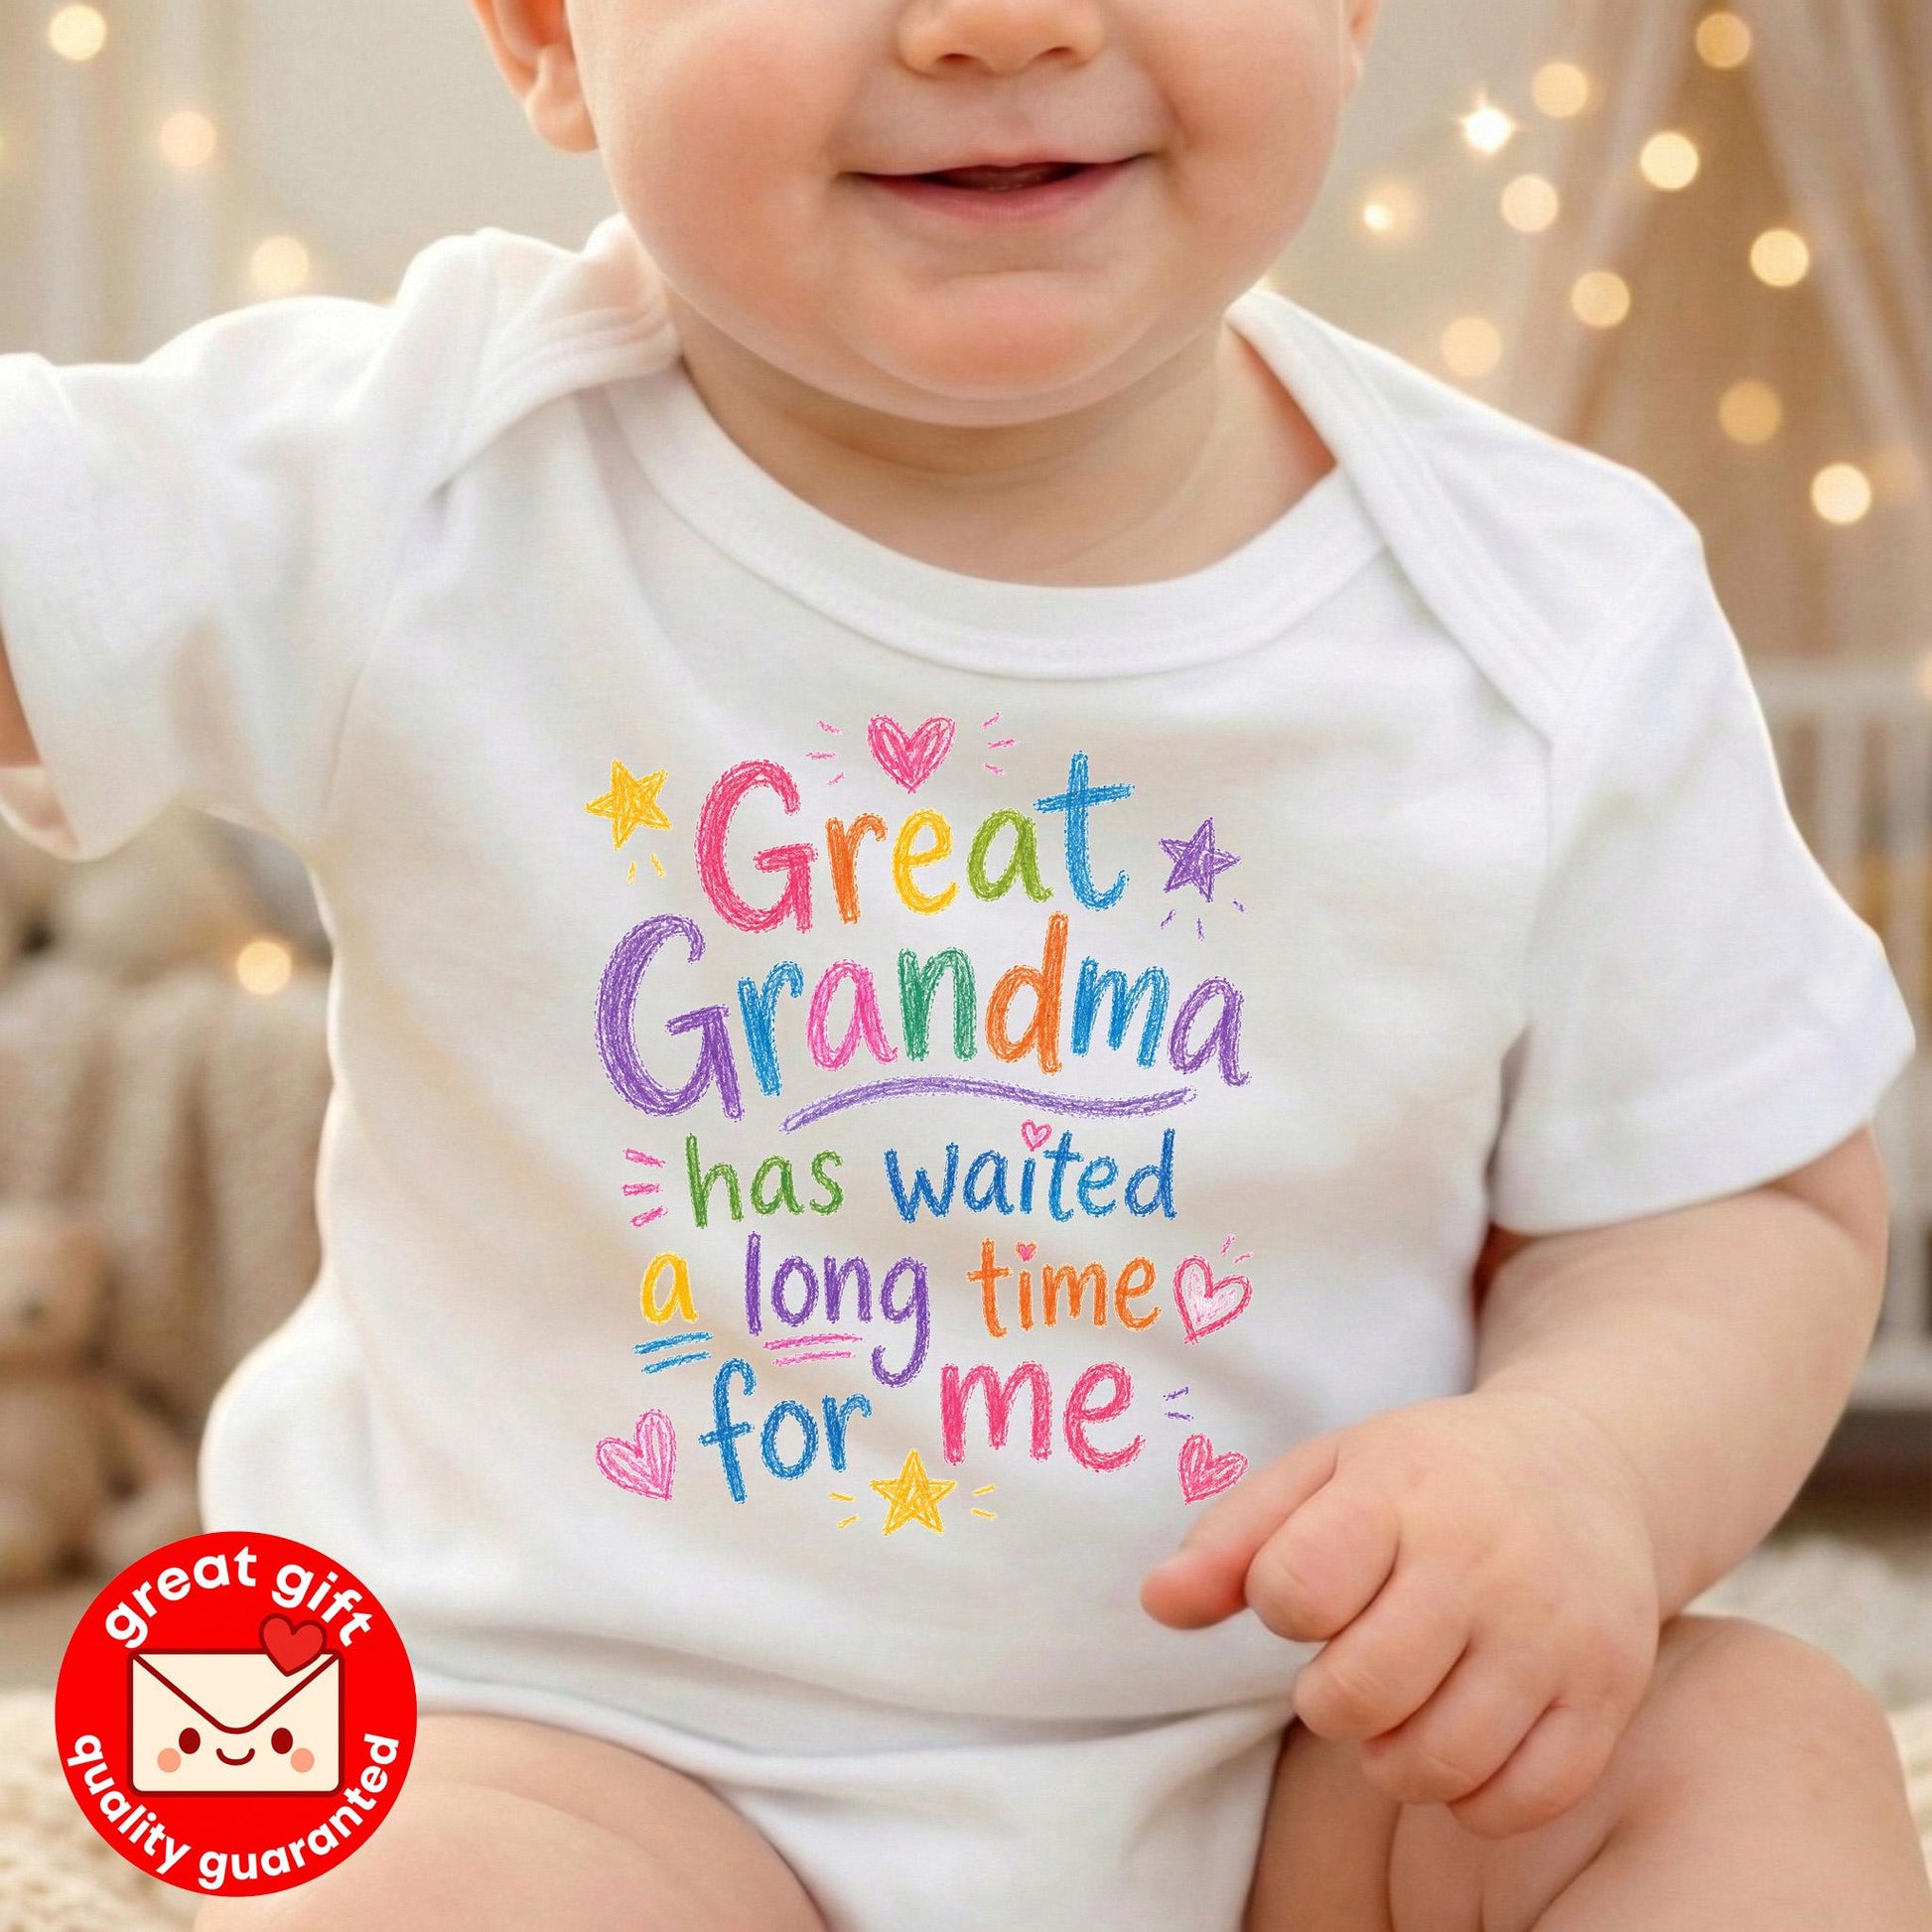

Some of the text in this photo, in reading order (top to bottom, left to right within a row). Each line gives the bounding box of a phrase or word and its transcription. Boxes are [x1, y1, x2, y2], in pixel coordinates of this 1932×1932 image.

[695, 751, 1136, 933] Great
[594, 910, 1252, 1123] Grandma
[684, 1119, 1178, 1229] has waited
[638, 1230, 1163, 1388] a long time
[697, 1356, 1148, 1505] for me
